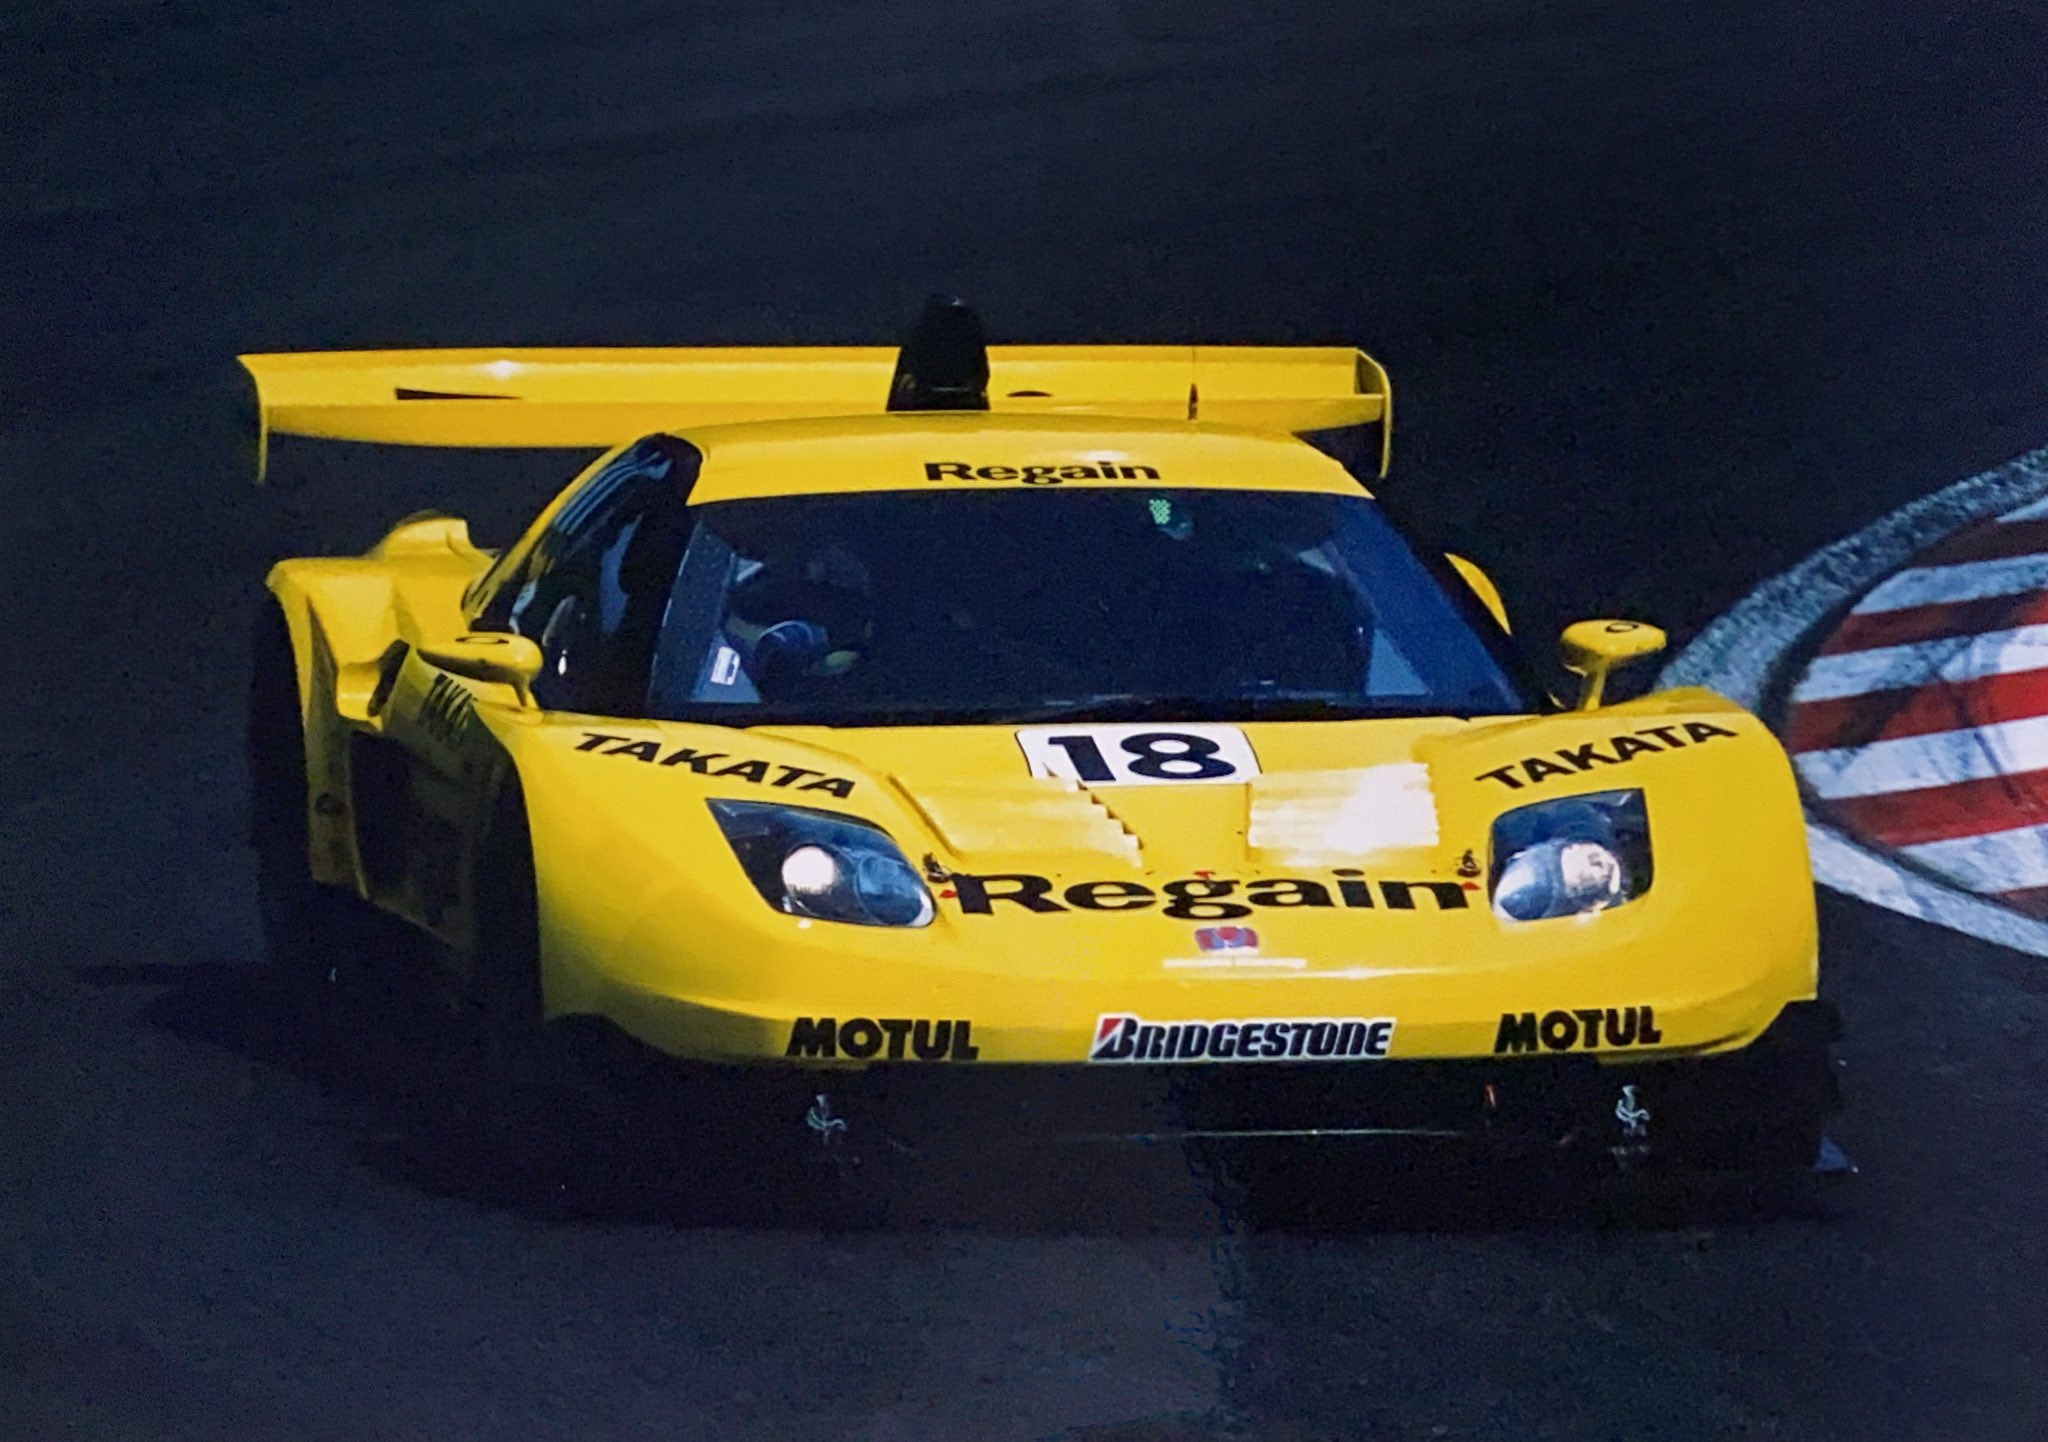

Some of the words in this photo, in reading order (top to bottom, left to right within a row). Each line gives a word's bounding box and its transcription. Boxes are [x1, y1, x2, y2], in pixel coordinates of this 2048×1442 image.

[924, 460, 1161, 485] Regain
[574, 732, 857, 799] TAKATA
[1048, 732, 1237, 782] 18
[1474, 722, 1739, 789] TAKATA
[949, 869, 1470, 920] Regain
[784, 1017, 980, 1061] MOTUL
[1091, 1018, 1392, 1059] BRIDGESTONE
[1494, 1006, 1662, 1054] MOTUL
